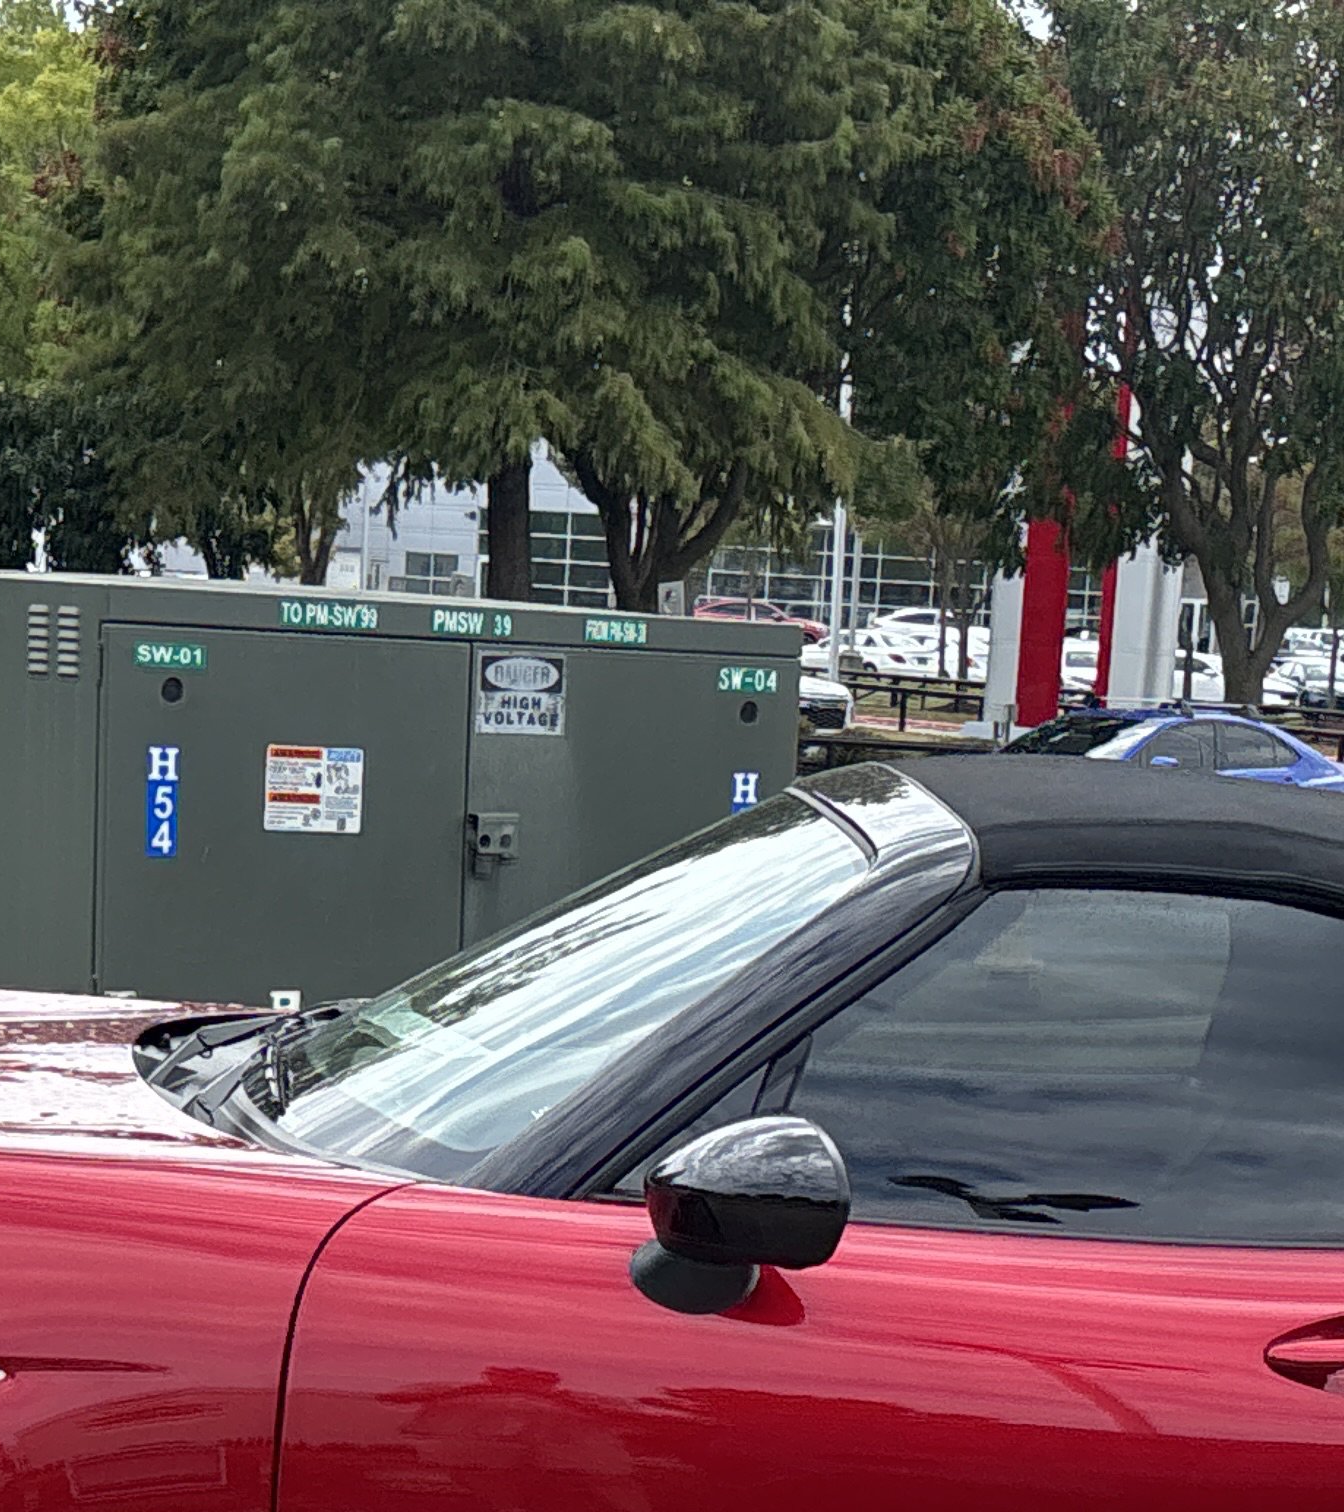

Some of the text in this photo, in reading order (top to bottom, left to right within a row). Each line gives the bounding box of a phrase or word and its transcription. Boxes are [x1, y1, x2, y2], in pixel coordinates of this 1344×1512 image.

[281, 601, 303, 624] TO
[433, 609, 512, 636] PMSW 39
[137, 644, 202, 666] SW-01
[494, 664, 551, 685] DANGER
[718, 668, 777, 692] SW-04
[500, 695, 542, 711] HIGH
[483, 711, 559, 727] VOLTAGE
[733, 772, 759, 804] H
